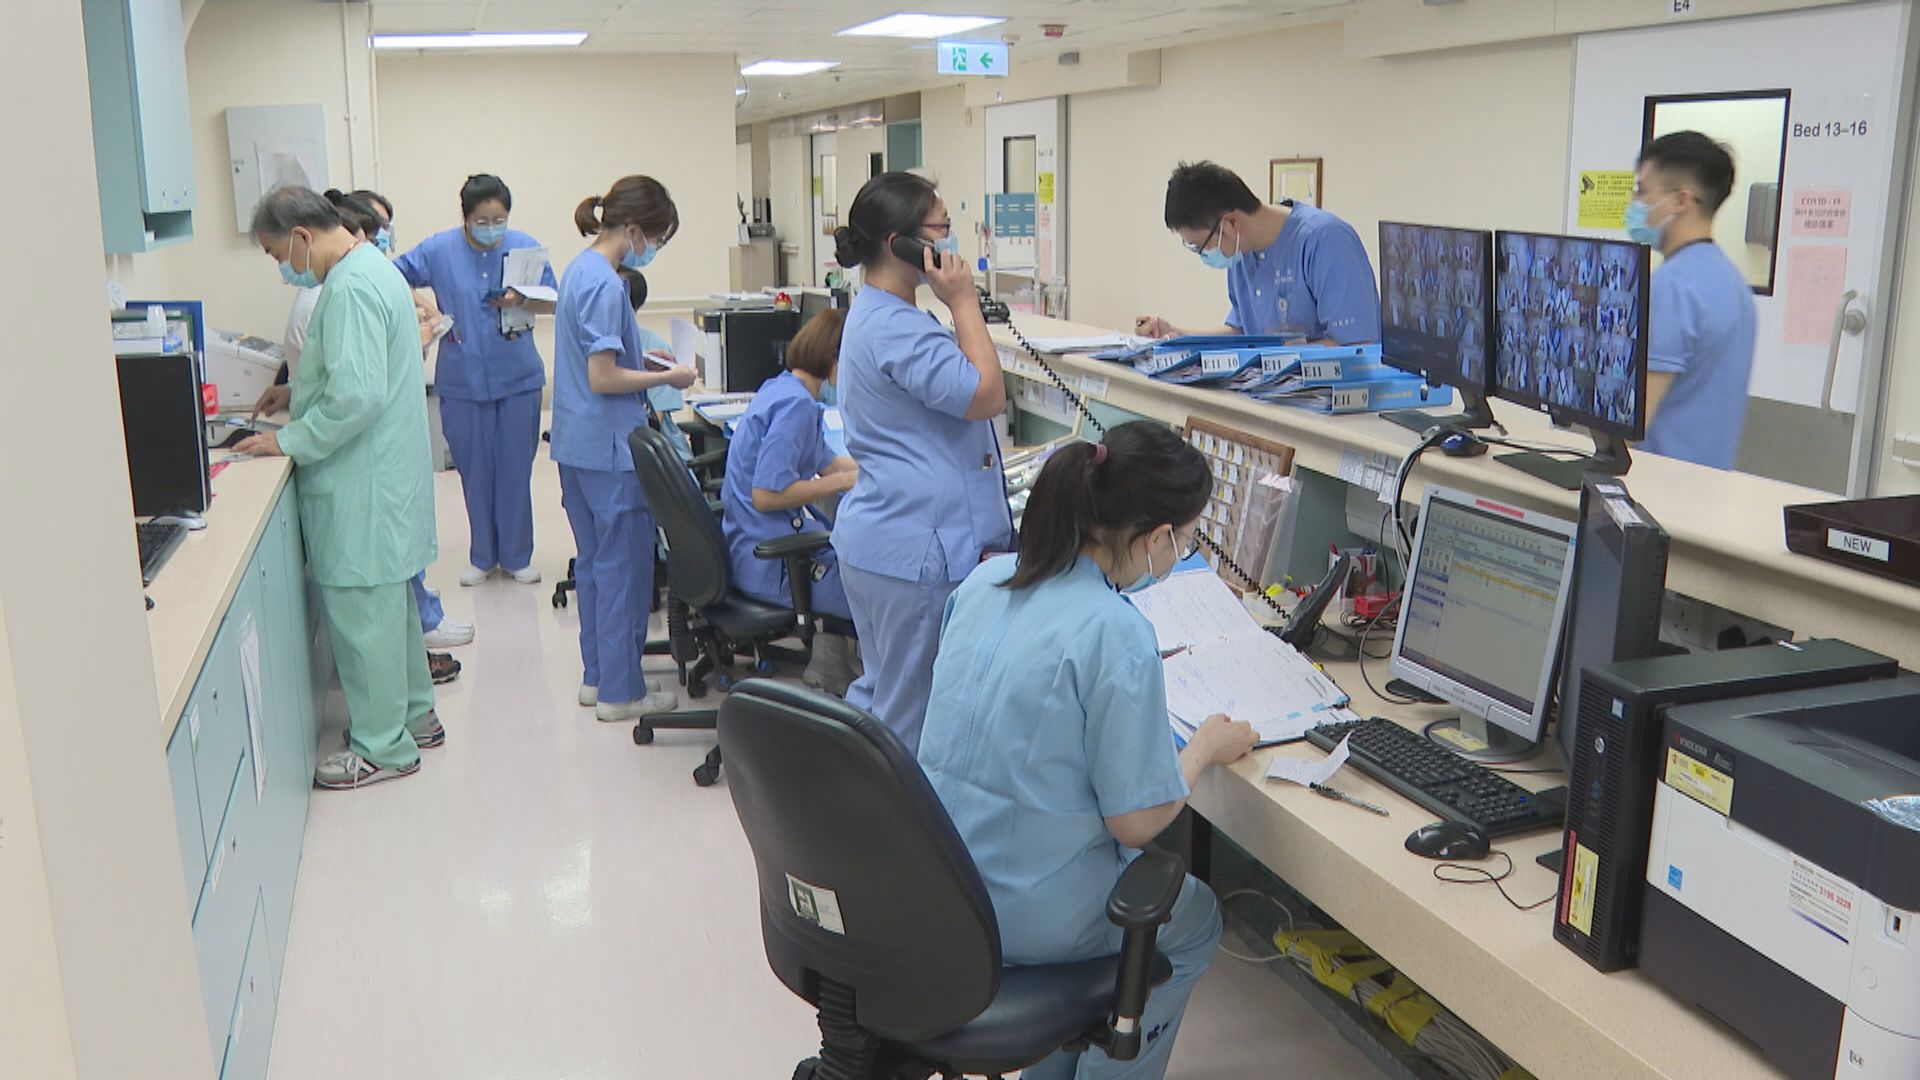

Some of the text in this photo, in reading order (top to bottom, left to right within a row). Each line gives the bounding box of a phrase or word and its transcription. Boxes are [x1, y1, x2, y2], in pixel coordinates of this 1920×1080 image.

[1674, 0, 1690, 13] E4
[1793, 122, 1820, 137] Bed
[1801, 197, 1827, 205] COVID
[1204, 358, 1239, 369] E11 10
[1264, 359, 1282, 371] E11
[1304, 366, 1322, 377] E11
[1334, 365, 1341, 376] 8
[1334, 394, 1350, 406] E11
[1361, 393, 1368, 404] 9
[1843, 535, 1873, 553] NEW
